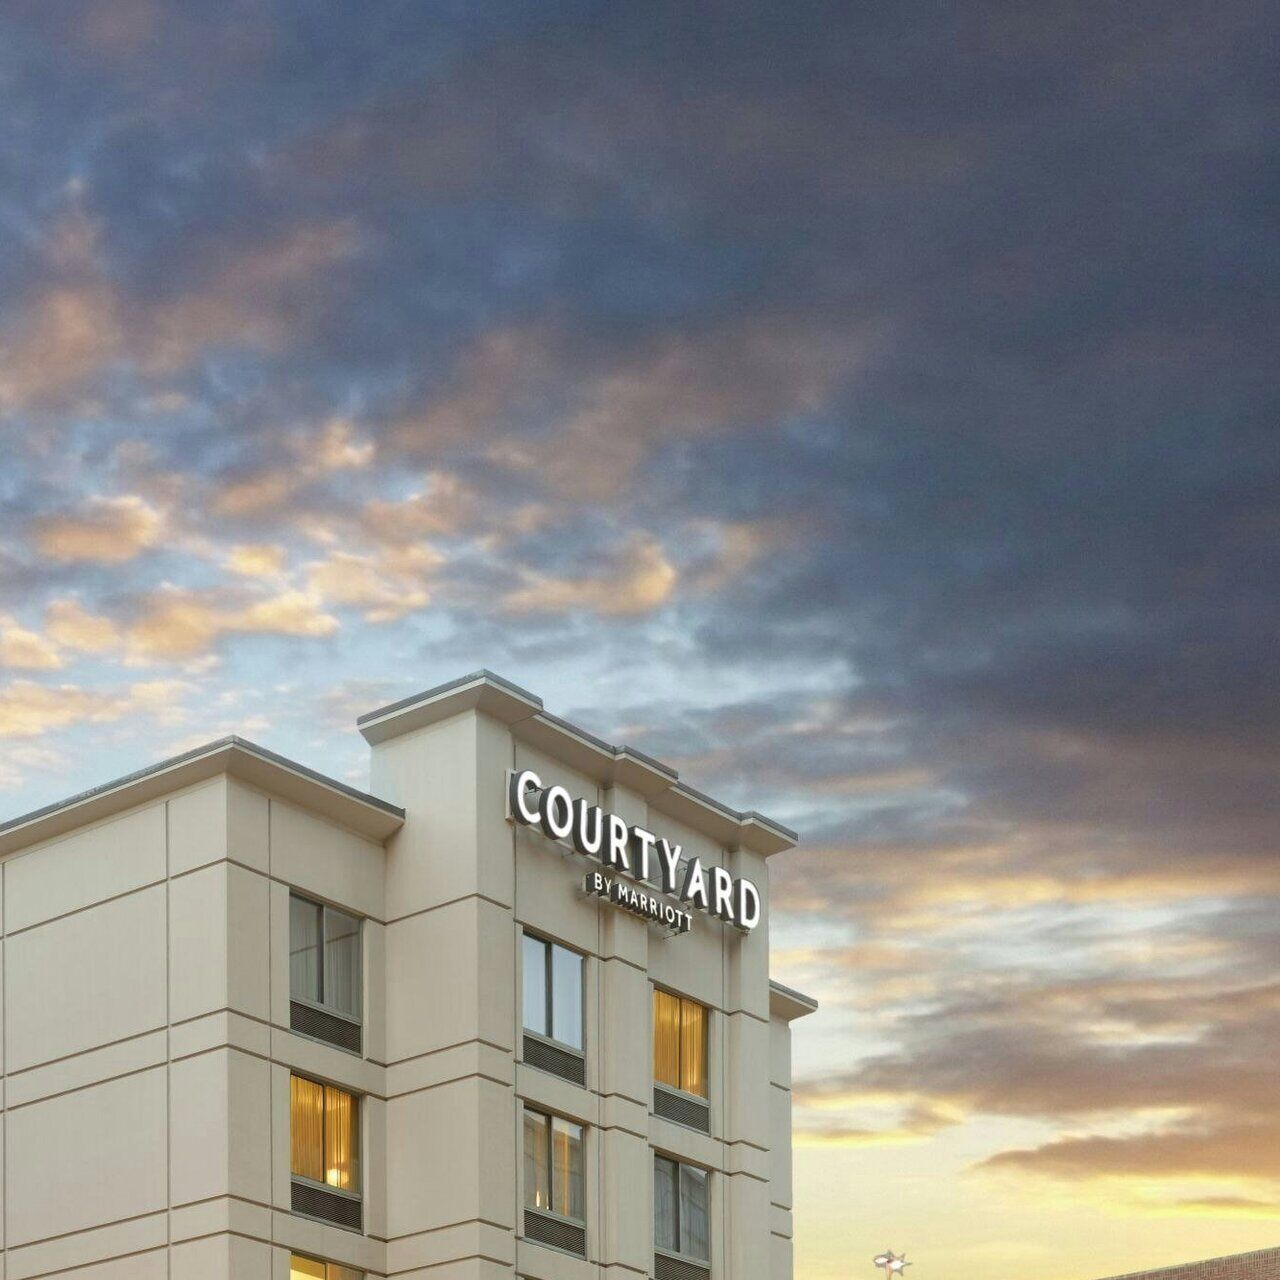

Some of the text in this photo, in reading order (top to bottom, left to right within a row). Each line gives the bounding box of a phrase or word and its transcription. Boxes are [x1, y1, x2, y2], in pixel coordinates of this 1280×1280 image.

[513, 770, 761, 930] COURTYARD
[592, 871, 693, 931] BY MARRIOTT
